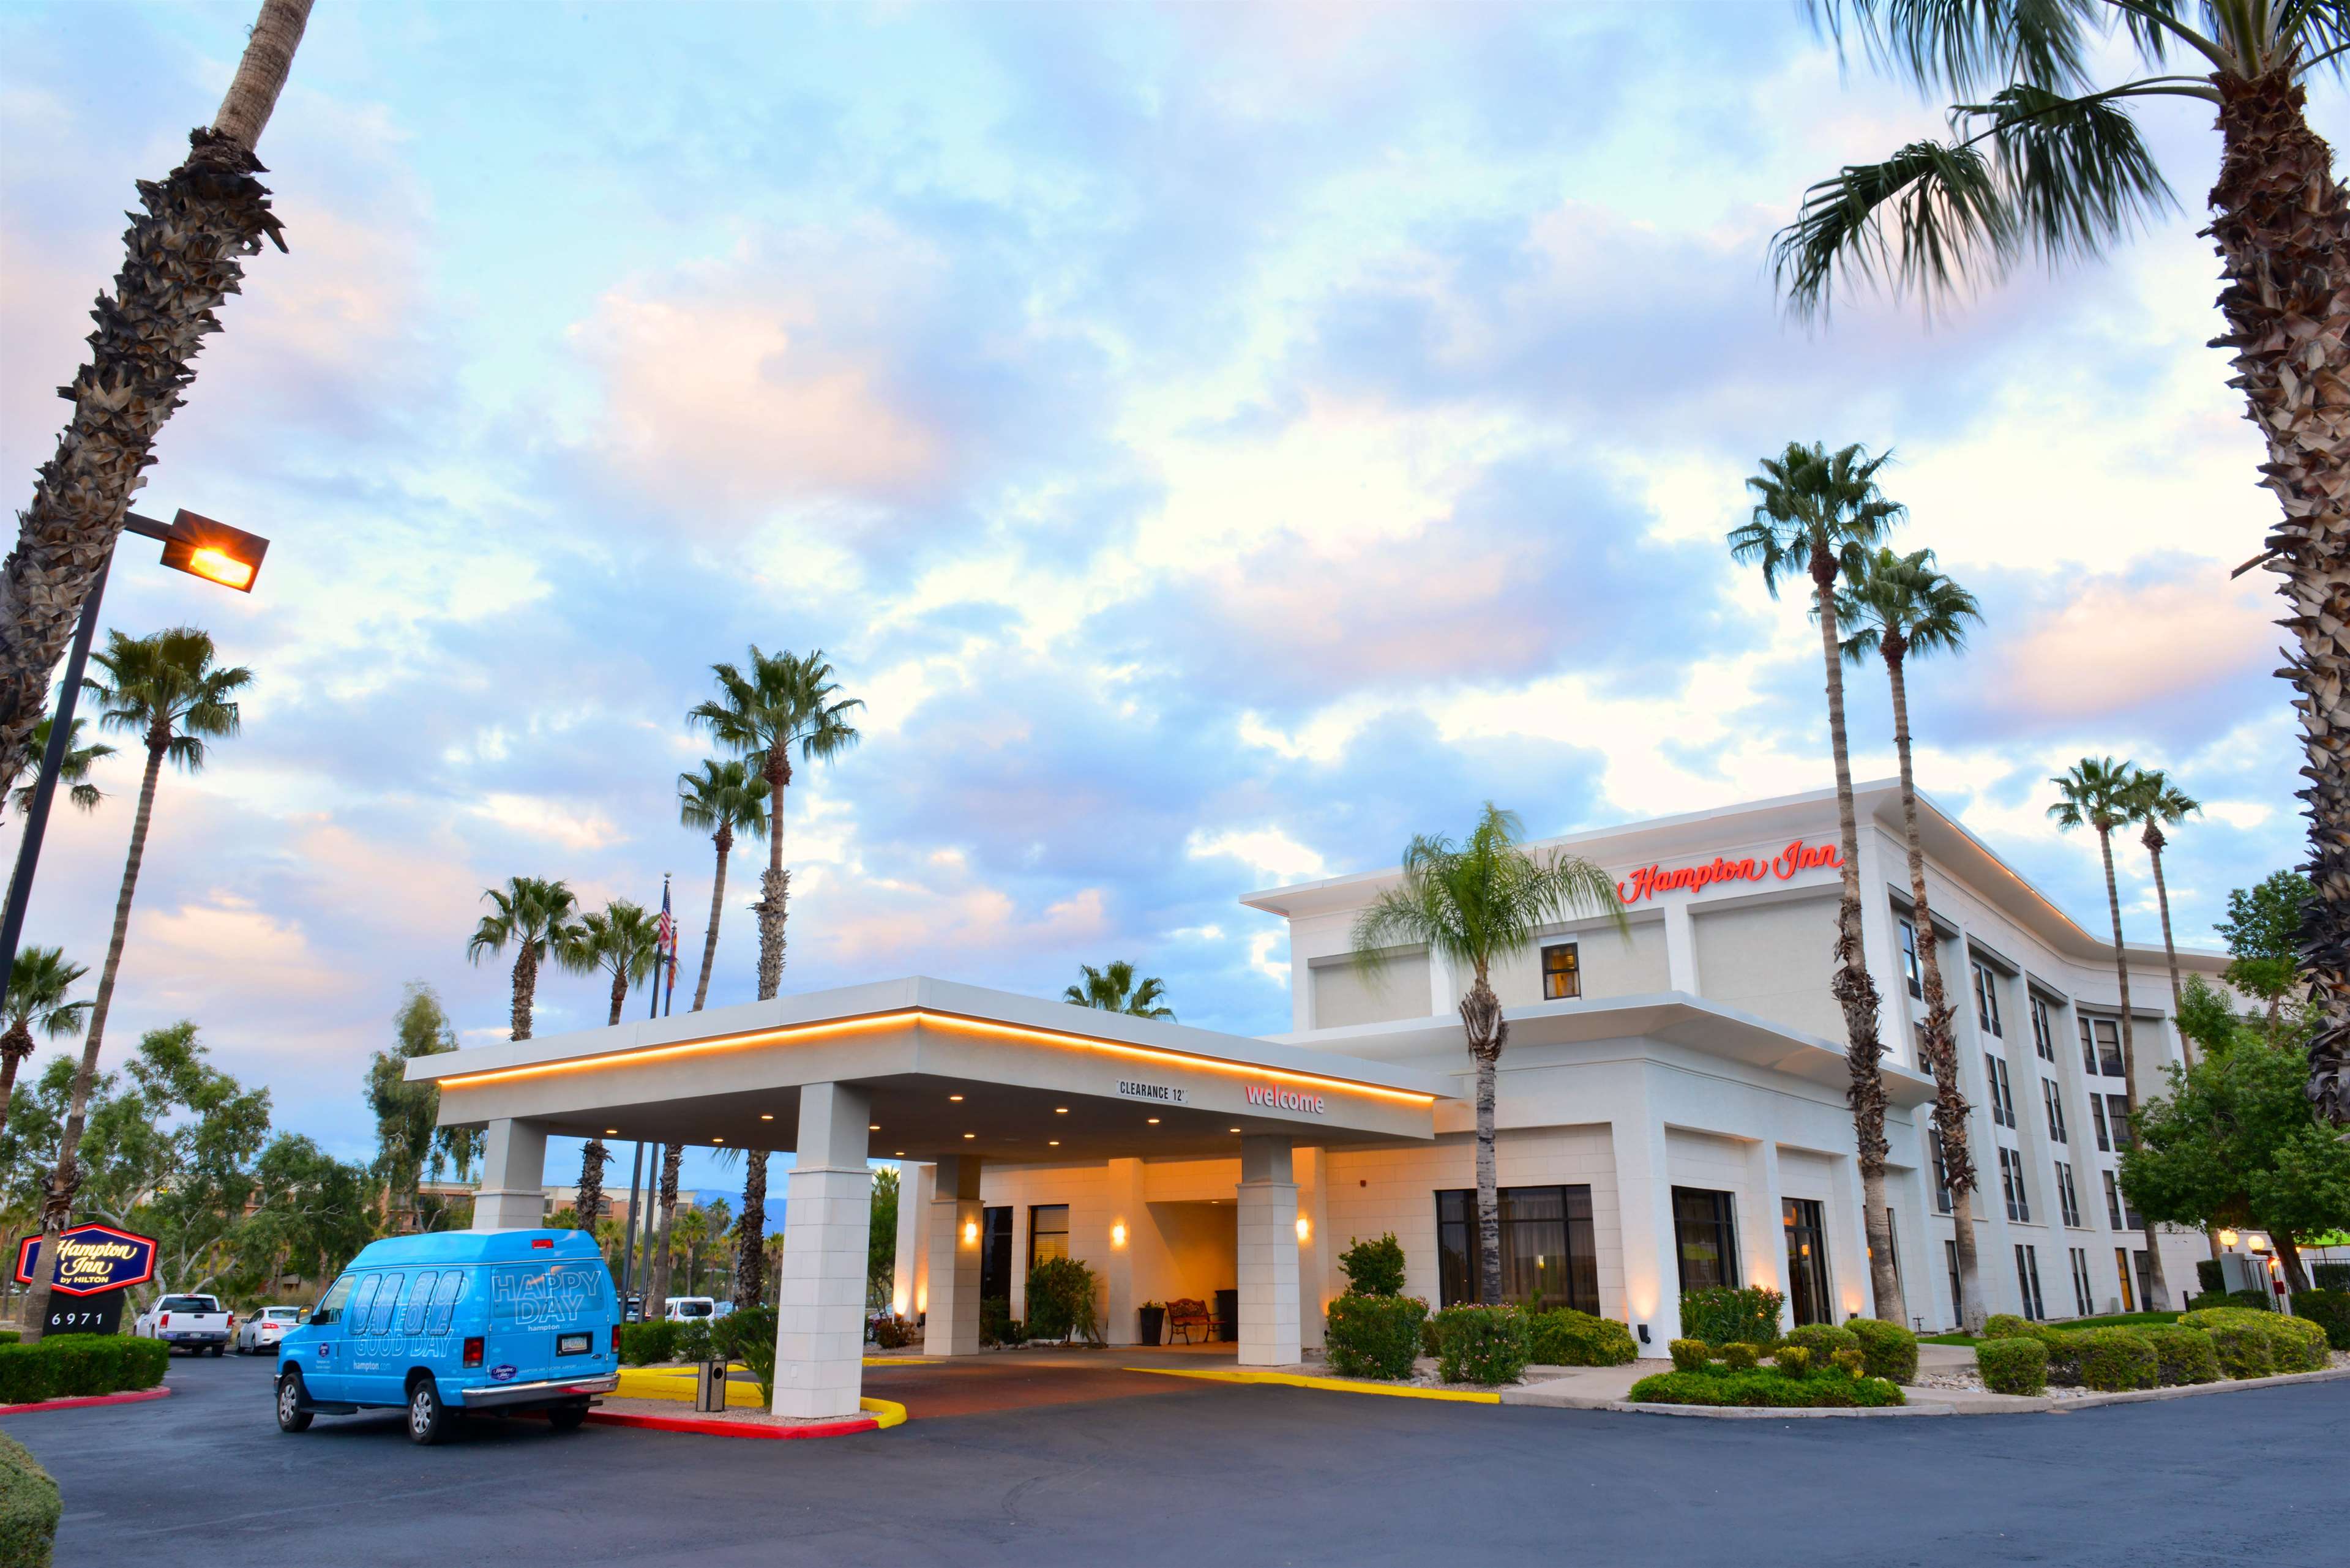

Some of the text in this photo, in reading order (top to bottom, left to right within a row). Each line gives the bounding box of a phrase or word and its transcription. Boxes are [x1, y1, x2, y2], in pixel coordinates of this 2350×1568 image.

[1617, 840, 1845, 904] Hampton Inn
[1120, 1081, 1184, 1102] CLEARANCE 12'
[1246, 1083, 1324, 1114] welcome
[56, 1239, 138, 1261] Hampton
[61, 1256, 113, 1276] Inn
[411, 1277, 468, 1305] GOOD
[492, 1271, 601, 1302] HAPPY
[51, 1313, 102, 1325] 6971
[354, 1304, 452, 1331] DAY FOR A
[515, 1294, 584, 1324] DAY
[354, 1329, 454, 1357] GOOD DAY
